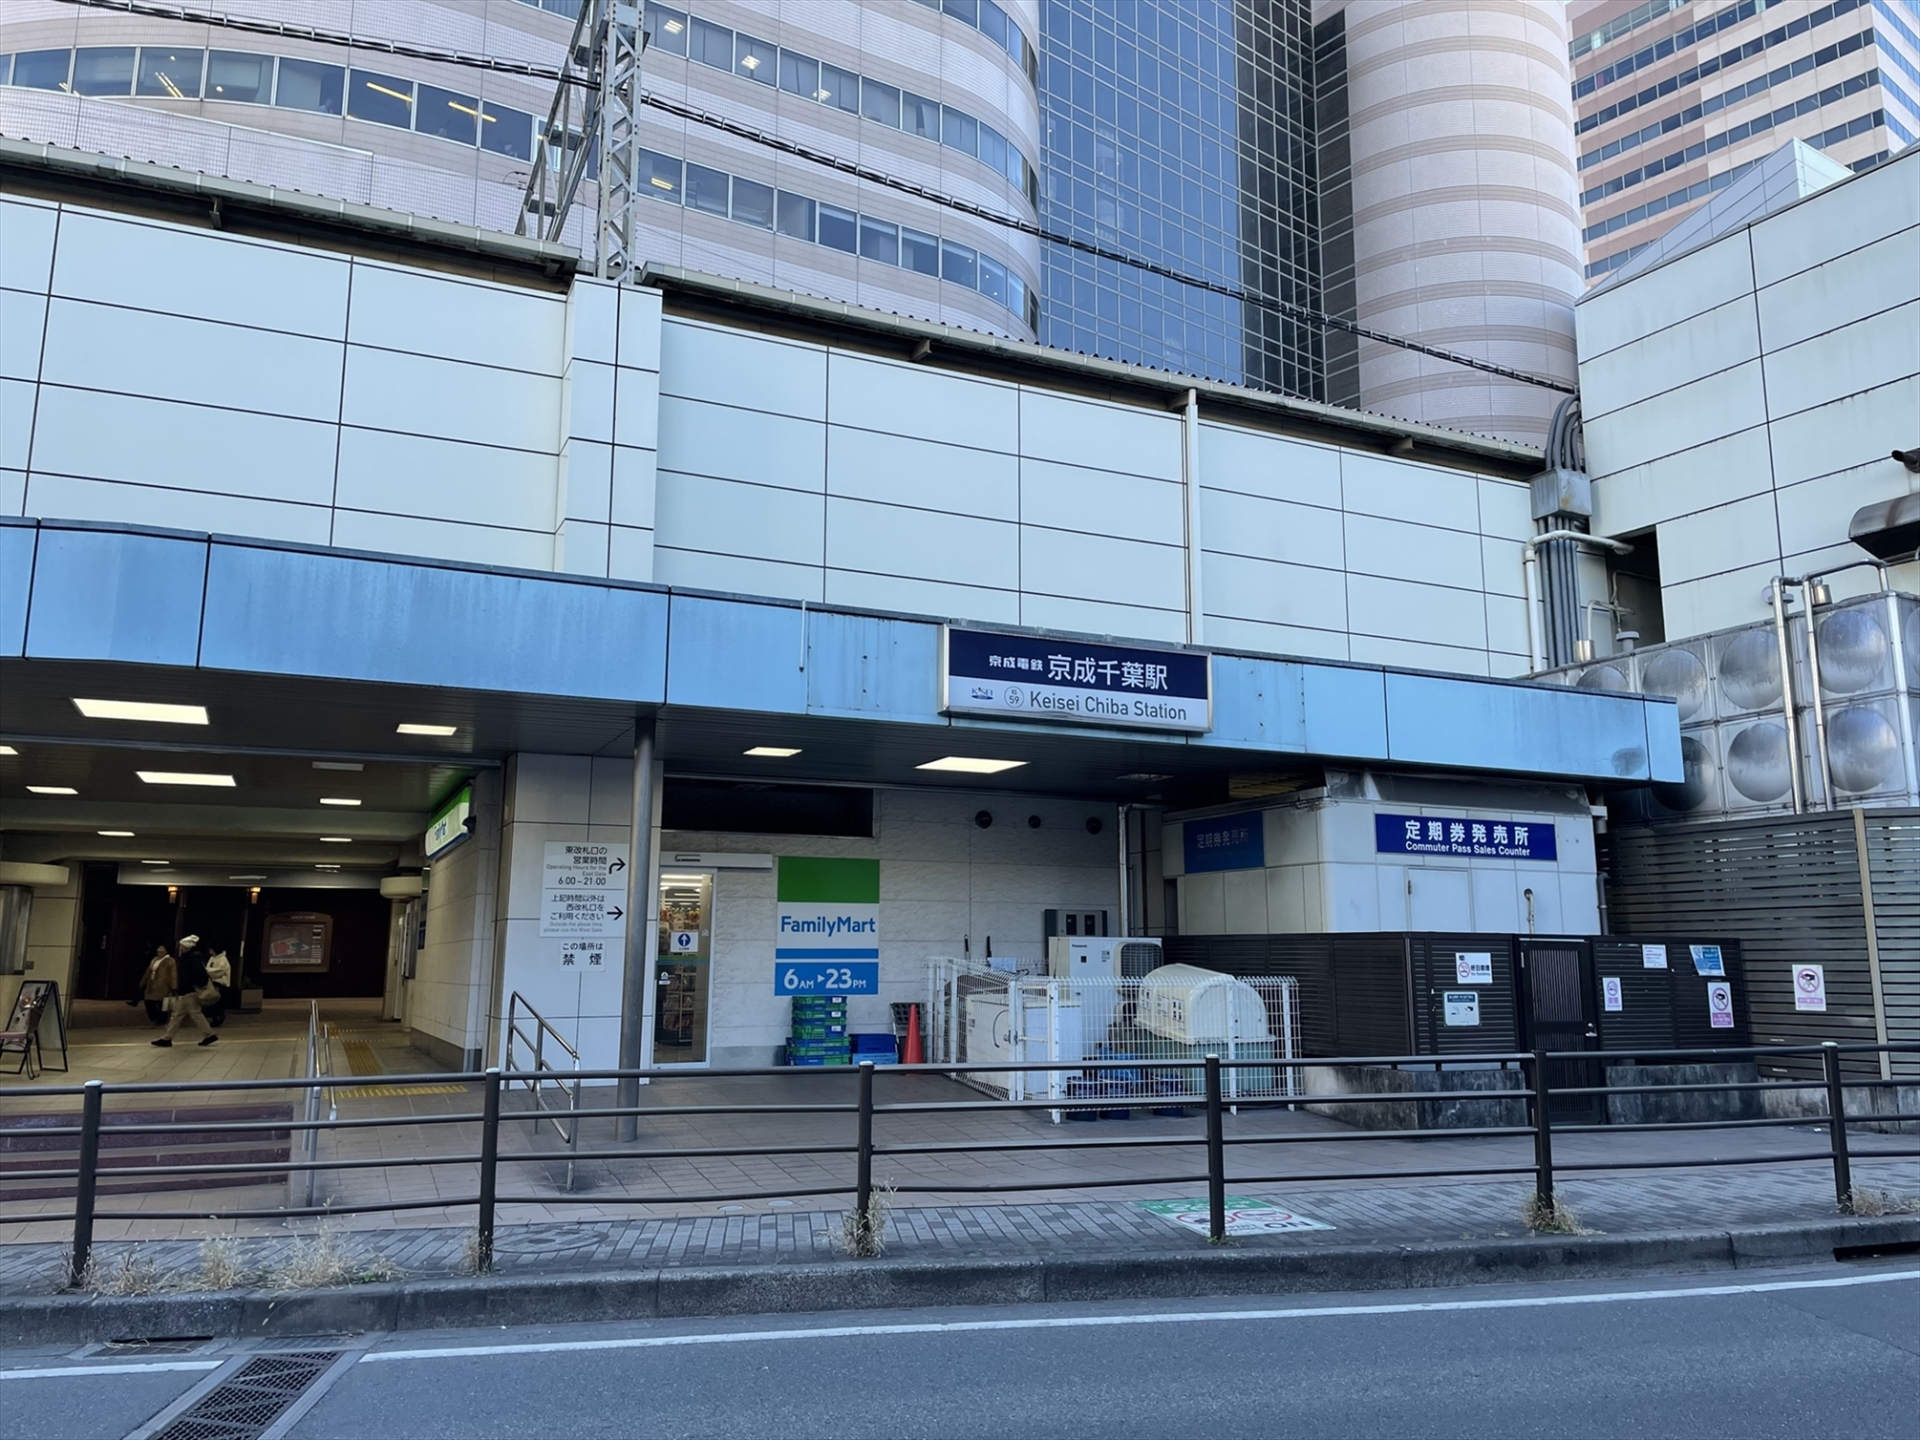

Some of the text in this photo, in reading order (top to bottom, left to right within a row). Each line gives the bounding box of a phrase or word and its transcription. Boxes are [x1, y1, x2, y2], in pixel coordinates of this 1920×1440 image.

[989, 654, 1168, 690] 京成電鉄 京成千葉駅
[1009, 695, 1020, 704] 59
[1030, 691, 1187, 721] Keisei Chiba Station
[1405, 820, 1529, 846] 定期券発売所
[565, 846, 607, 855] 東改札口の
[1405, 841, 1530, 856] Commuter Pass Sales Counter
[573, 856, 607, 865] 営業時間
[551, 894, 605, 902] 上記時間以外は
[550, 912, 604, 920] ご利用ください
[781, 916, 876, 937] FamilyMart
[562, 942, 603, 951] この場所は
